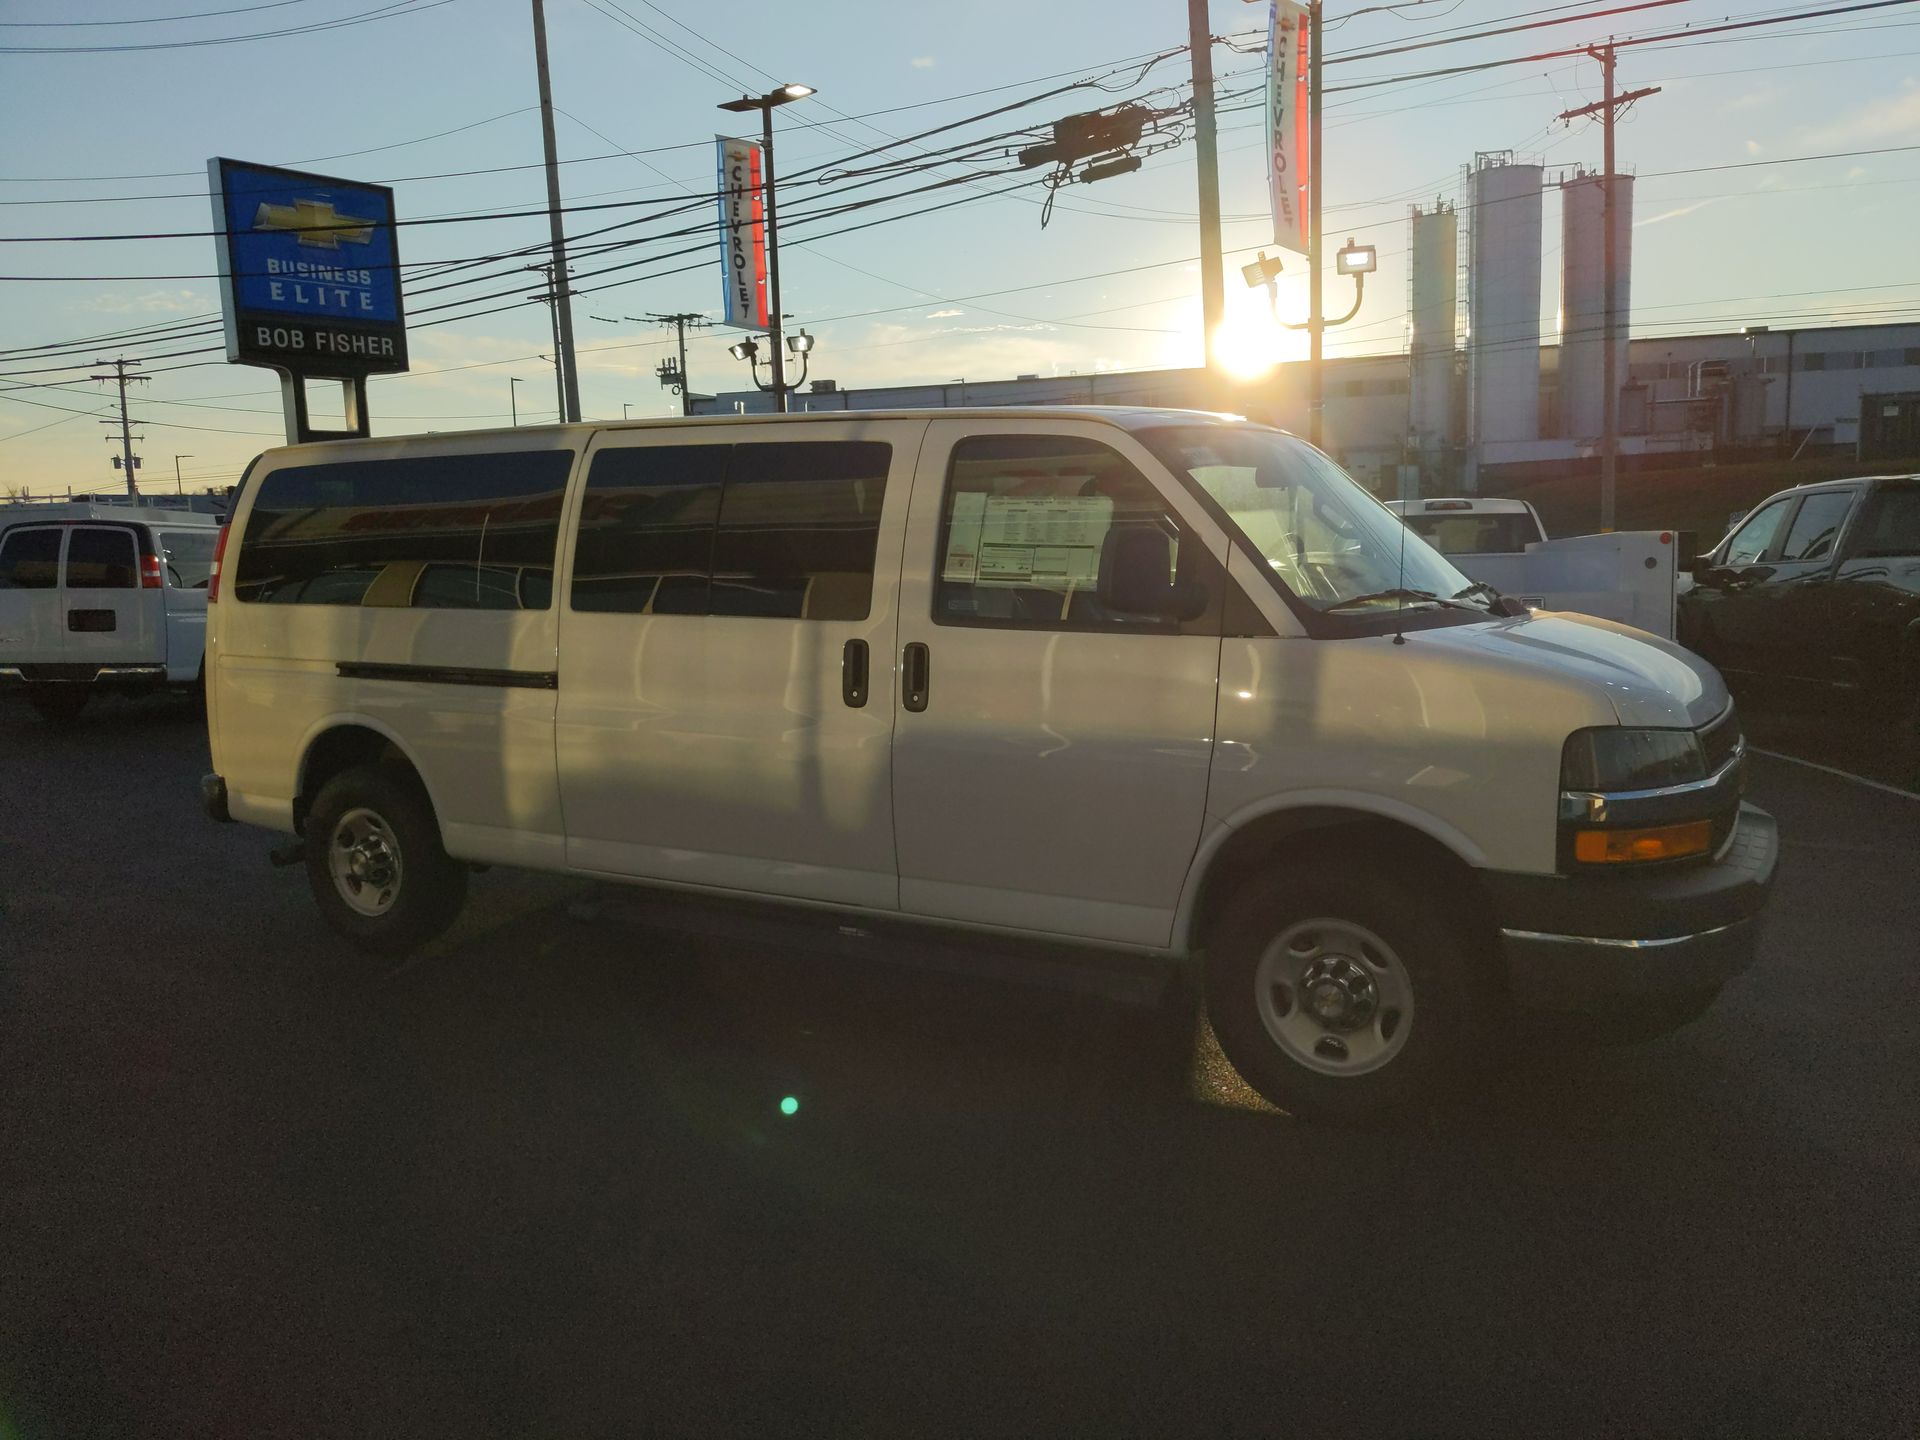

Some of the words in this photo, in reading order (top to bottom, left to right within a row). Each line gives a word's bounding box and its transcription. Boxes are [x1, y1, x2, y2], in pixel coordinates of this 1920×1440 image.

[731, 165, 750, 319] CHEVROLET
[267, 258, 371, 285] BUSINESS
[270, 282, 373, 310] ELITE
[257, 327, 305, 348] BOB
[315, 332, 394, 356] FISHER
